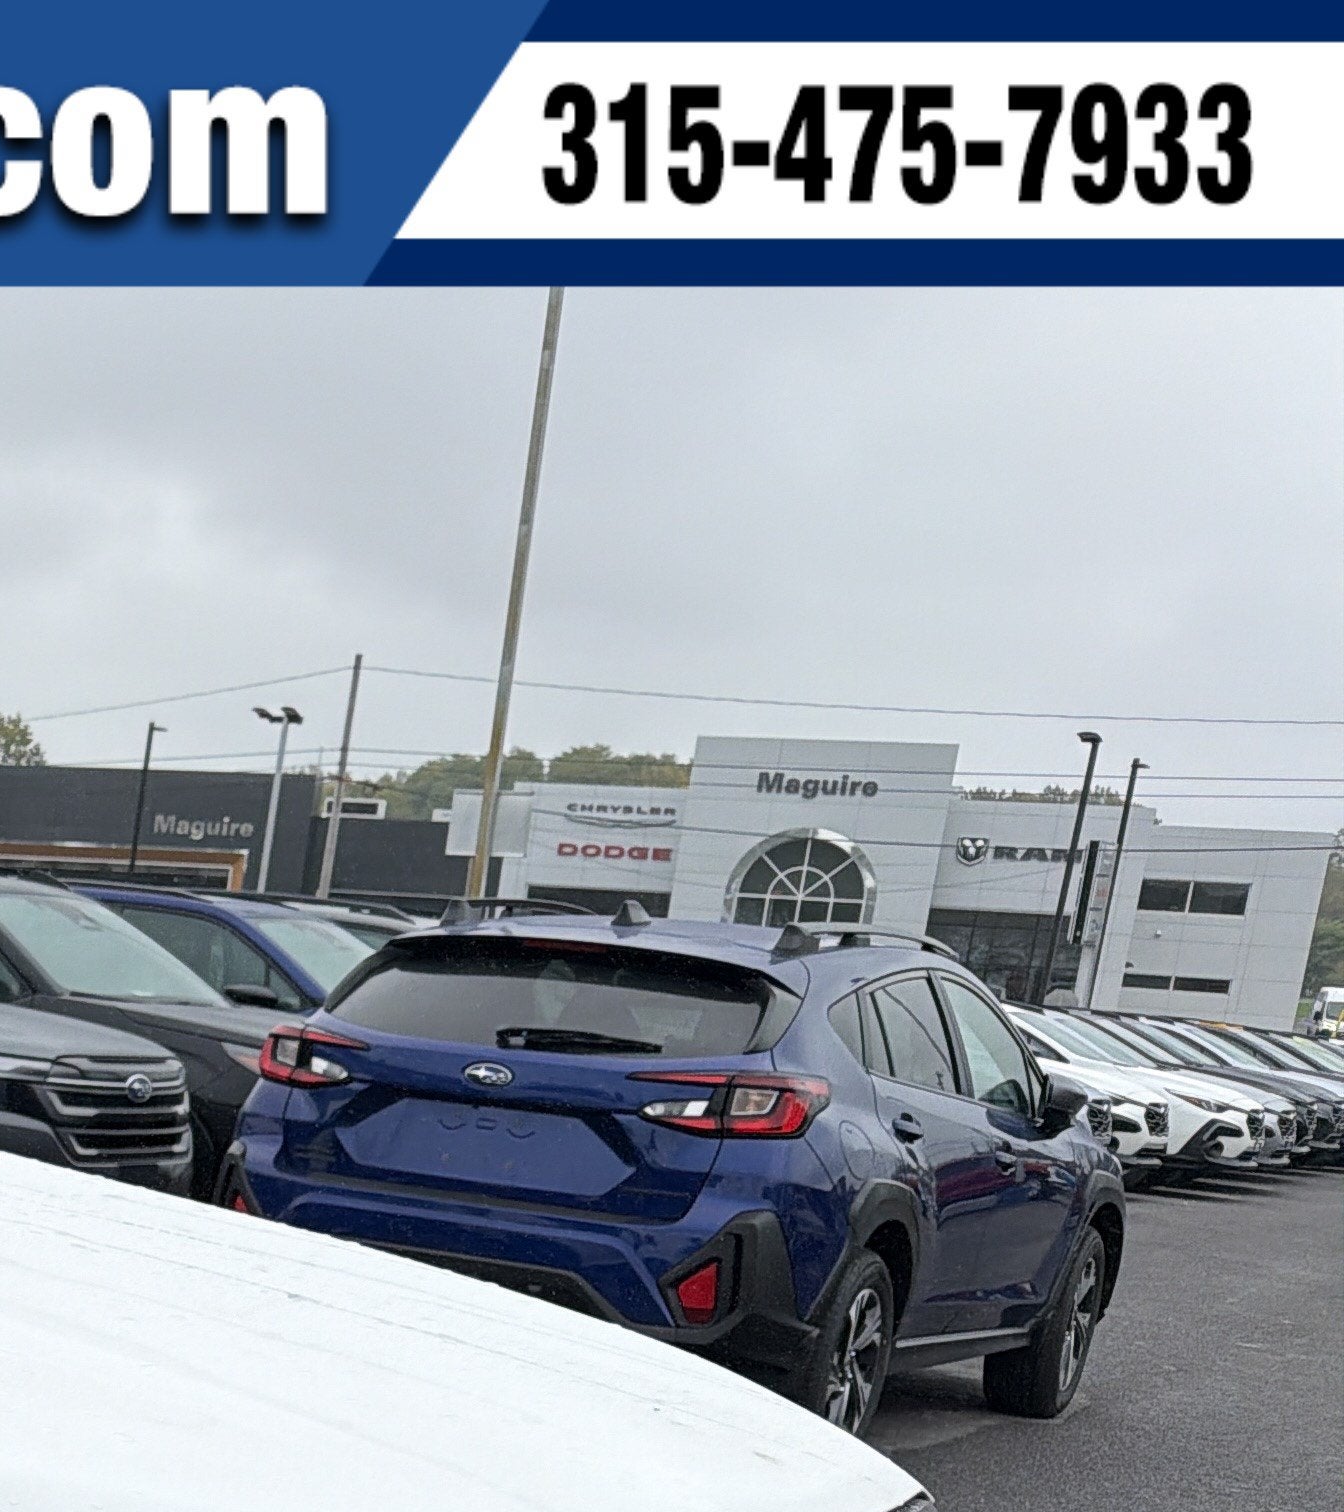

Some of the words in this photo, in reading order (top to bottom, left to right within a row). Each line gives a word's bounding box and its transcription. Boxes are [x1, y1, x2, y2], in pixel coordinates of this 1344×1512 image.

[756, 772, 879, 799] Maguire
[567, 803, 676, 816] CHRYSLER
[153, 814, 254, 840] Maguire
[557, 843, 673, 862] DODGE
[993, 846, 1084, 863] RAM
